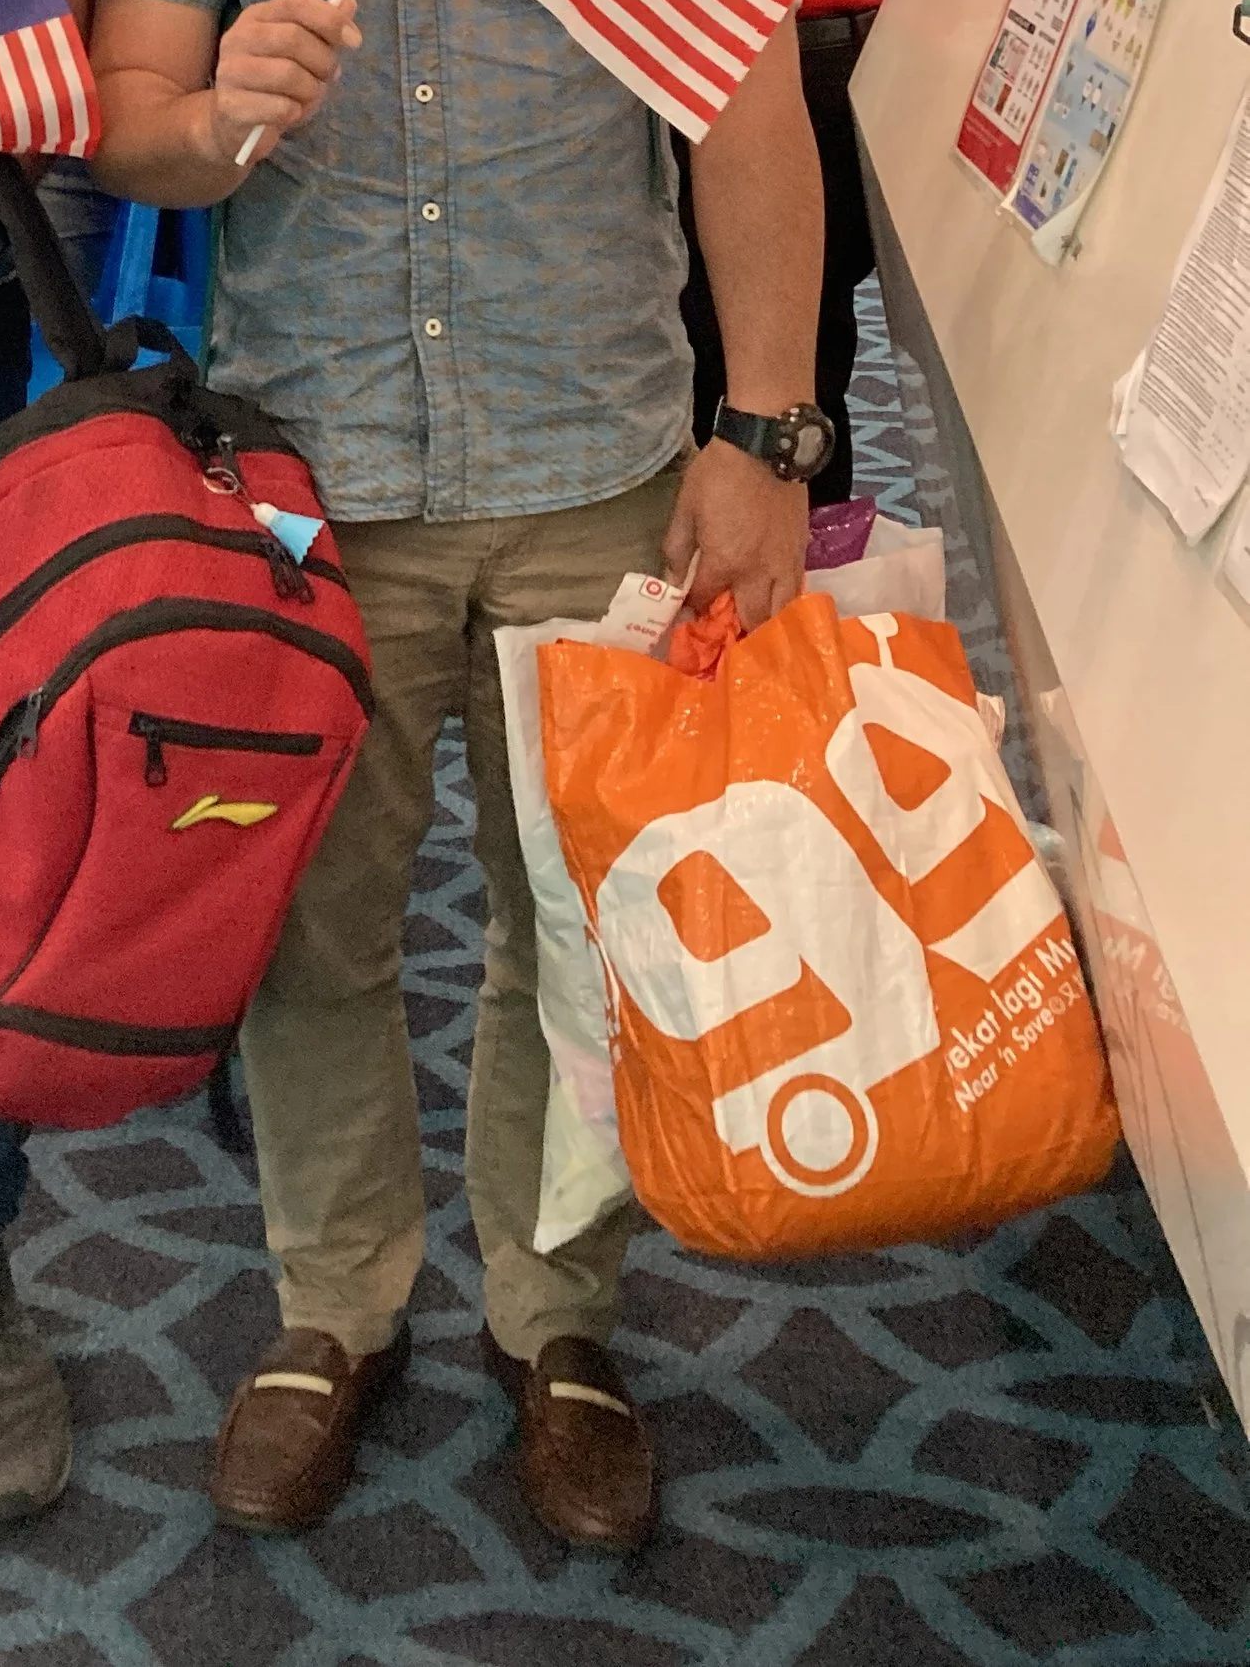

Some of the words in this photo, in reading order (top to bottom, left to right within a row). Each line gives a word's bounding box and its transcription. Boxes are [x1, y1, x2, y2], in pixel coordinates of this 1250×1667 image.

[944, 1008, 1001, 1077] ekat
[990, 961, 1045, 1022] lagi
[954, 1062, 999, 1113] Near
[1012, 1007, 1055, 1052] Save
